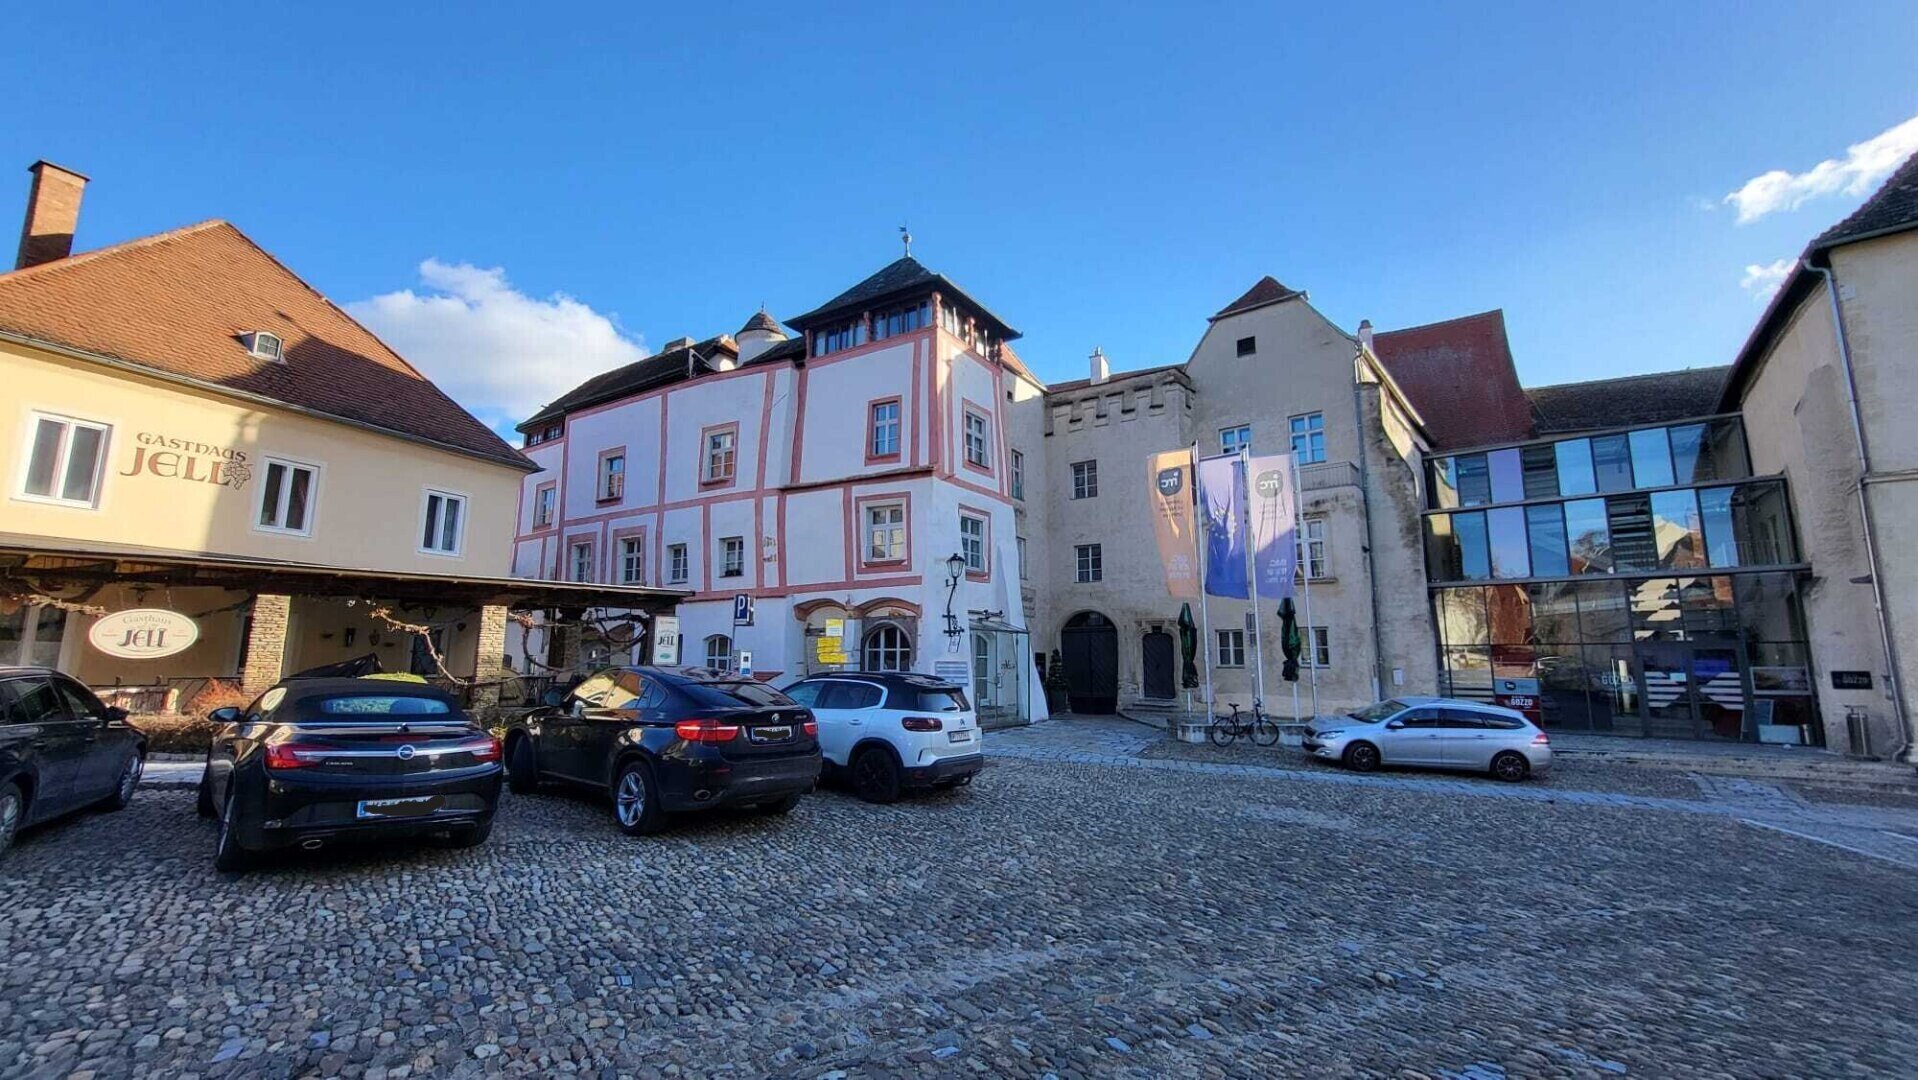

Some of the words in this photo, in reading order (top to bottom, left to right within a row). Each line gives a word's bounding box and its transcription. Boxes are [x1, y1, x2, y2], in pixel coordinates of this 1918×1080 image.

[136, 432, 246, 462] GASTHAUS
[119, 447, 231, 487] JELL
[737, 595, 746, 618] P
[117, 627, 168, 648] JELL
